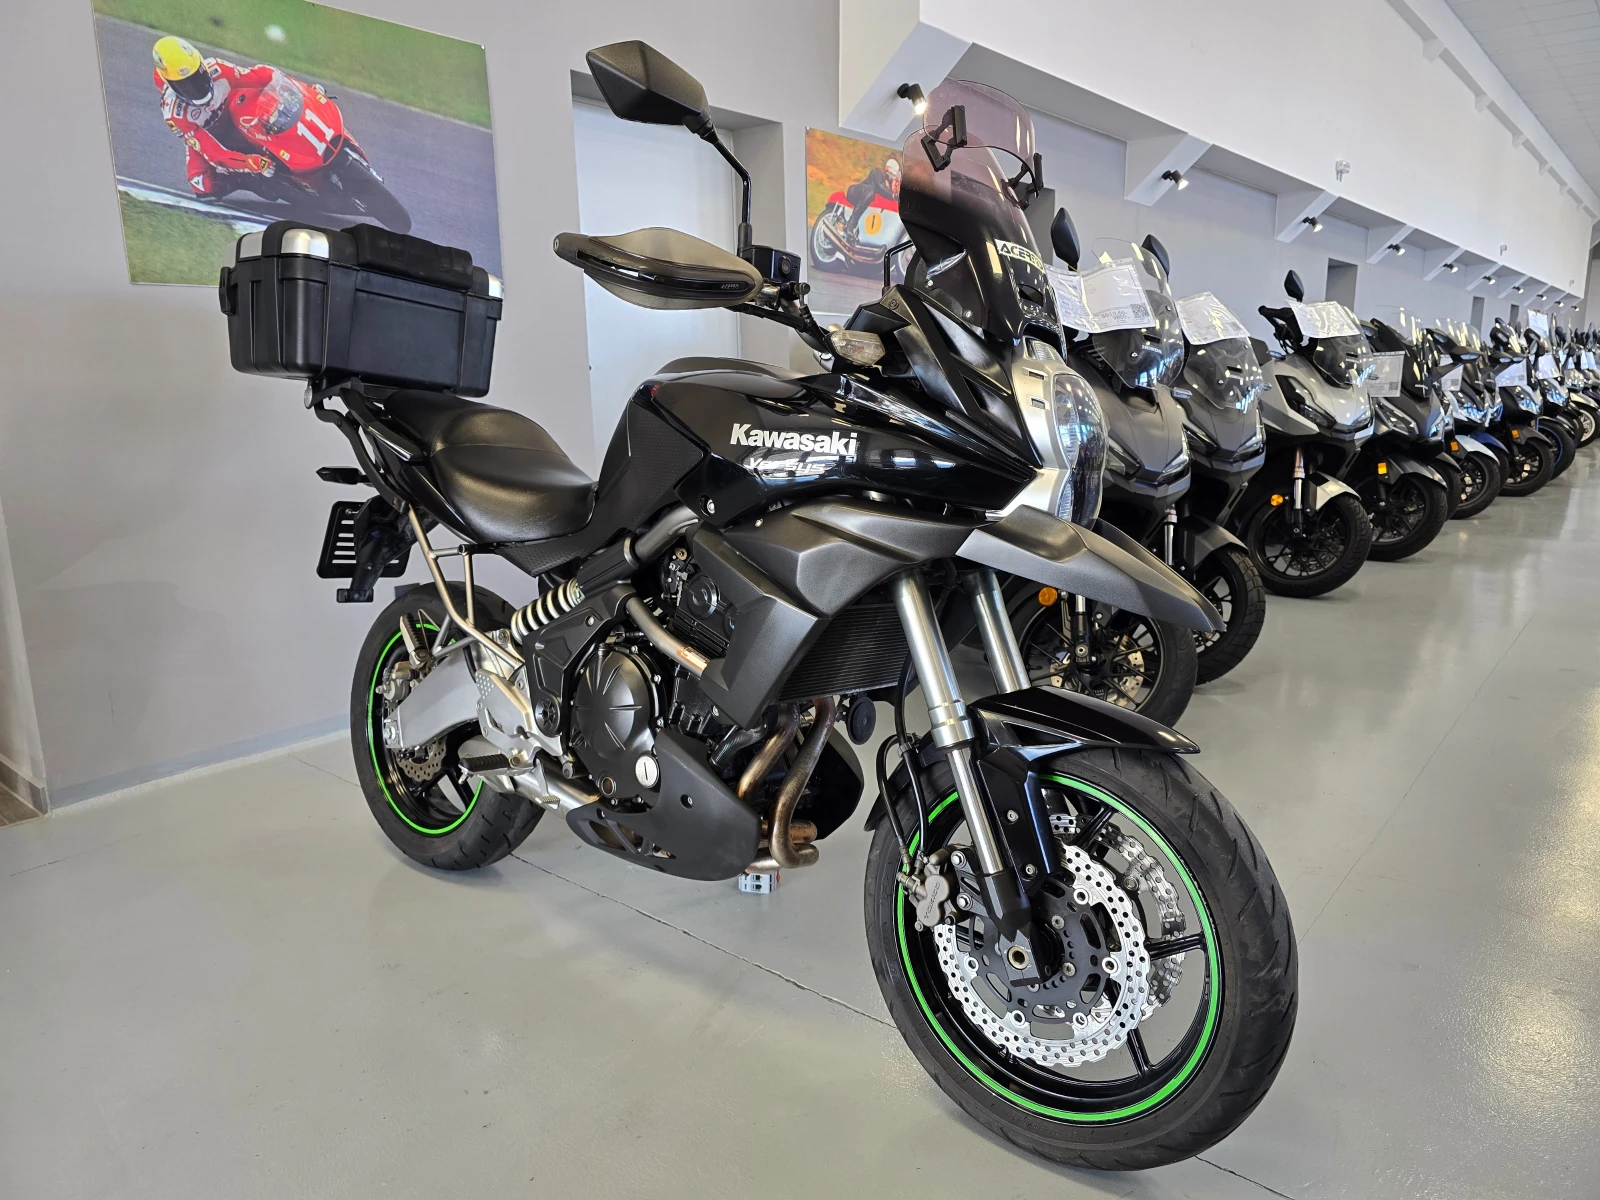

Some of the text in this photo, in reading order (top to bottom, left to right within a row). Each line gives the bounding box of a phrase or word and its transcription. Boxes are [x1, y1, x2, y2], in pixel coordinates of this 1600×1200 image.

[296, 108, 335, 156] 11
[1141, 344, 1163, 354] HONDA
[730, 423, 858, 456] Kawasaki
